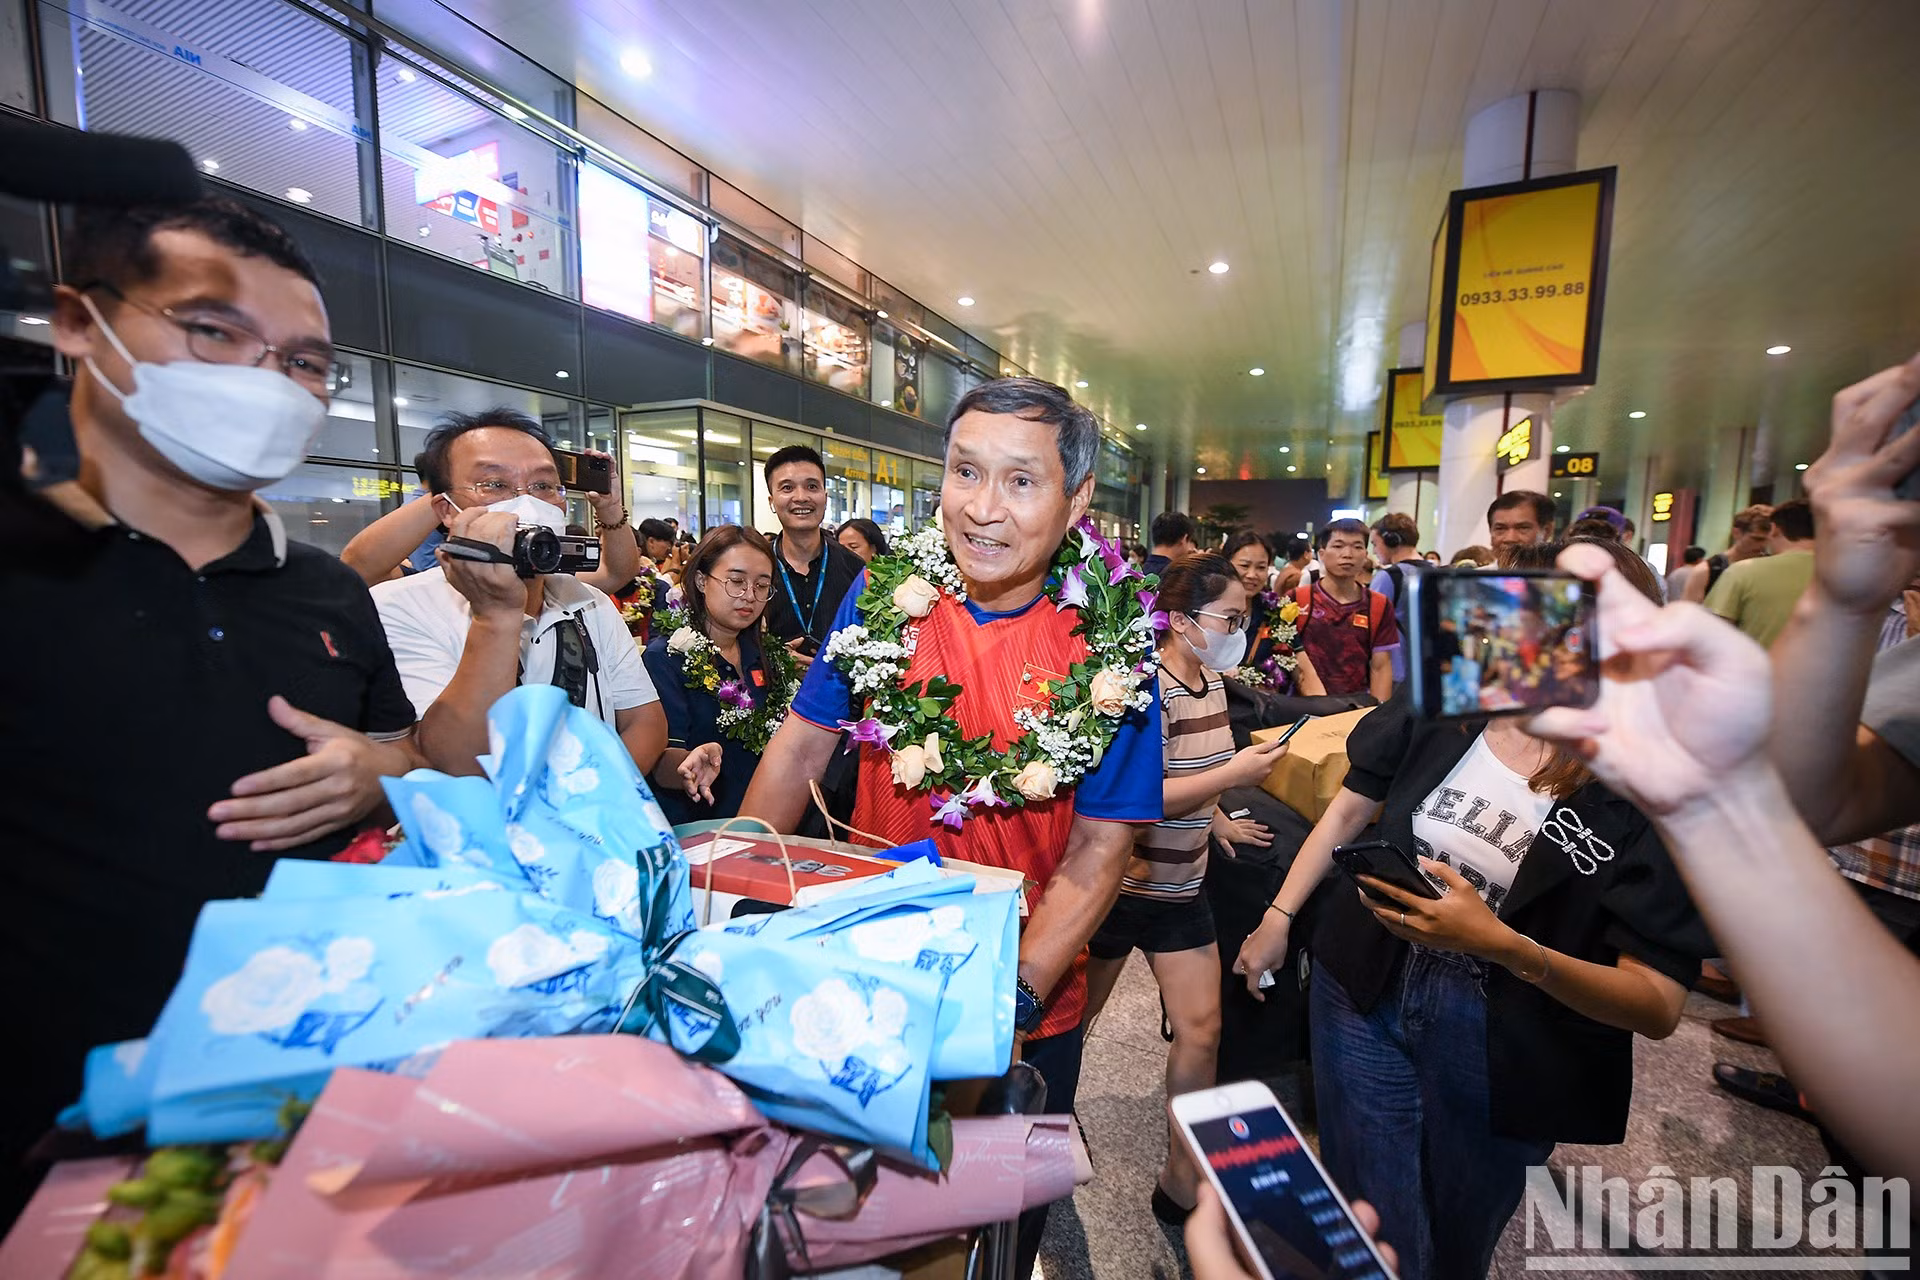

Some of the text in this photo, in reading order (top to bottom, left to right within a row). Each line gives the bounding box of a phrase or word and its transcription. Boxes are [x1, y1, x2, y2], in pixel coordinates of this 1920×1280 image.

[1460, 281, 1585, 306] 0933.33.99.88
[876, 455, 897, 485] A1
[1567, 457, 1593, 474] 08
